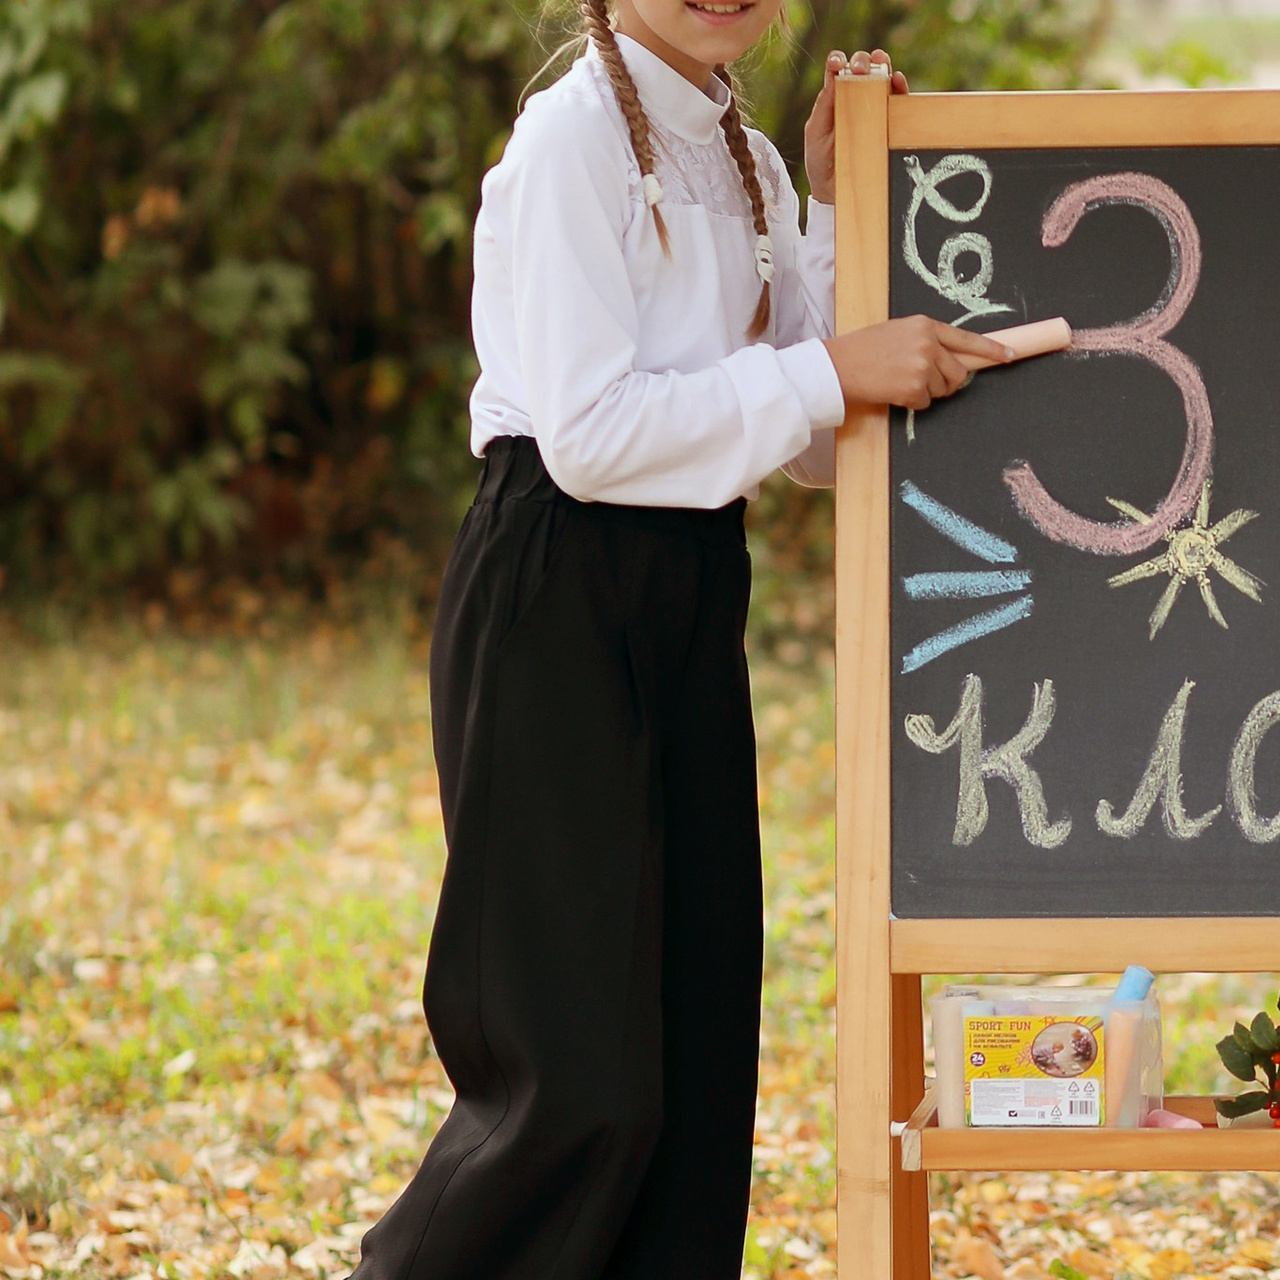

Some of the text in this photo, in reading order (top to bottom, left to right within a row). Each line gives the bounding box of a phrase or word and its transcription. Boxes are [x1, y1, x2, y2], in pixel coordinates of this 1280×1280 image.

[1003, 170, 1214, 557] 3
[969, 1021, 1031, 1031] SPORT FUN
[972, 1053, 984, 1062] 24
